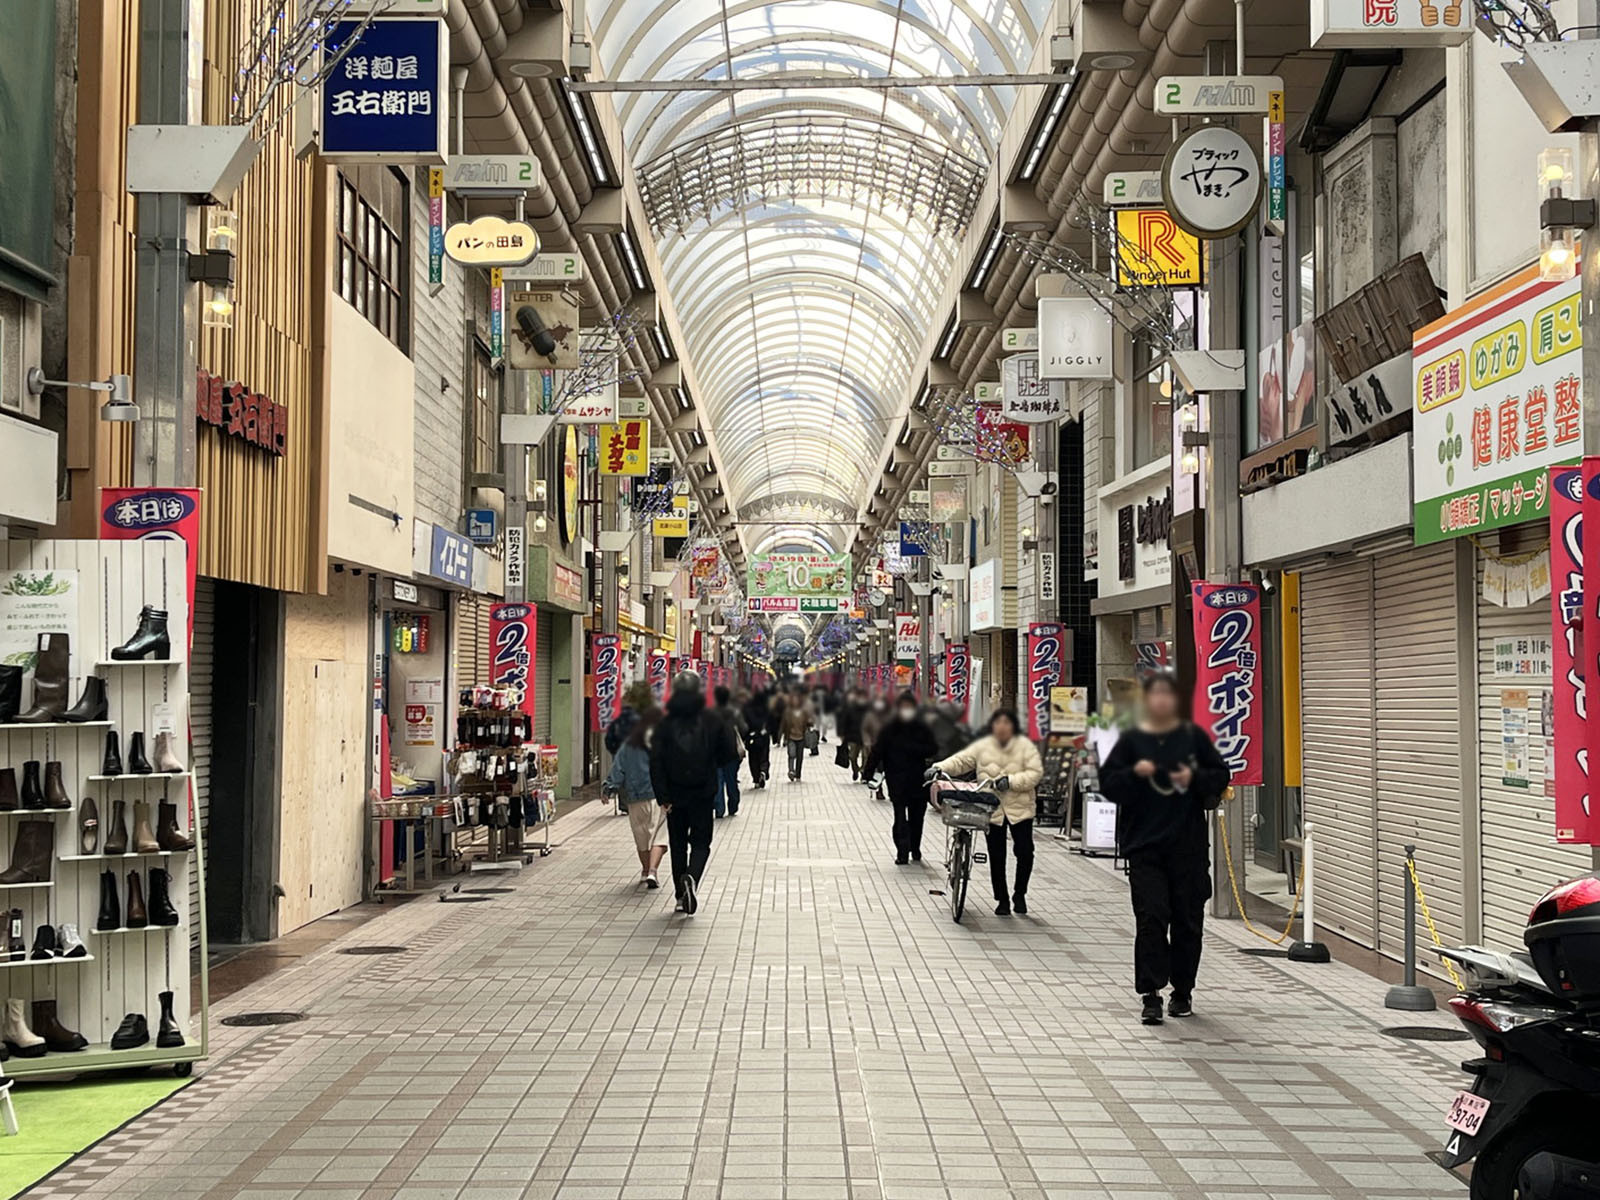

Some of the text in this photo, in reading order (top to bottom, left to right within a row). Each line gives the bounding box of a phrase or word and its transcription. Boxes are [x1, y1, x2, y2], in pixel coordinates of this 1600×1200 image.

[331, 90, 432, 115] 五右衛門
[1166, 84, 1181, 105] 2
[519, 162, 532, 180] 2
[1113, 179, 1126, 196] 2
[457, 235, 523, 249] パンの田島
[564, 258, 575, 275] 2
[1169, 269, 1191, 279] Hut
[513, 293, 552, 302] LETTER
[1007, 332, 1017, 346] 2
[1050, 356, 1103, 365] JIGGLY
[1476, 333, 1519, 379] ゆがみ
[979, 386, 988, 397] 2
[579, 407, 612, 417] ムサシヤ
[637, 401, 645, 412] 2
[1472, 373, 1581, 470] 健康堂整
[115, 498, 185, 527] 本日は
[508, 529, 520, 584] 防犯カメラ作動中
[1042, 554, 1052, 598] 防犯カメラ作動中
[1210, 591, 1249, 607] 本日は
[497, 608, 527, 621] 本日は
